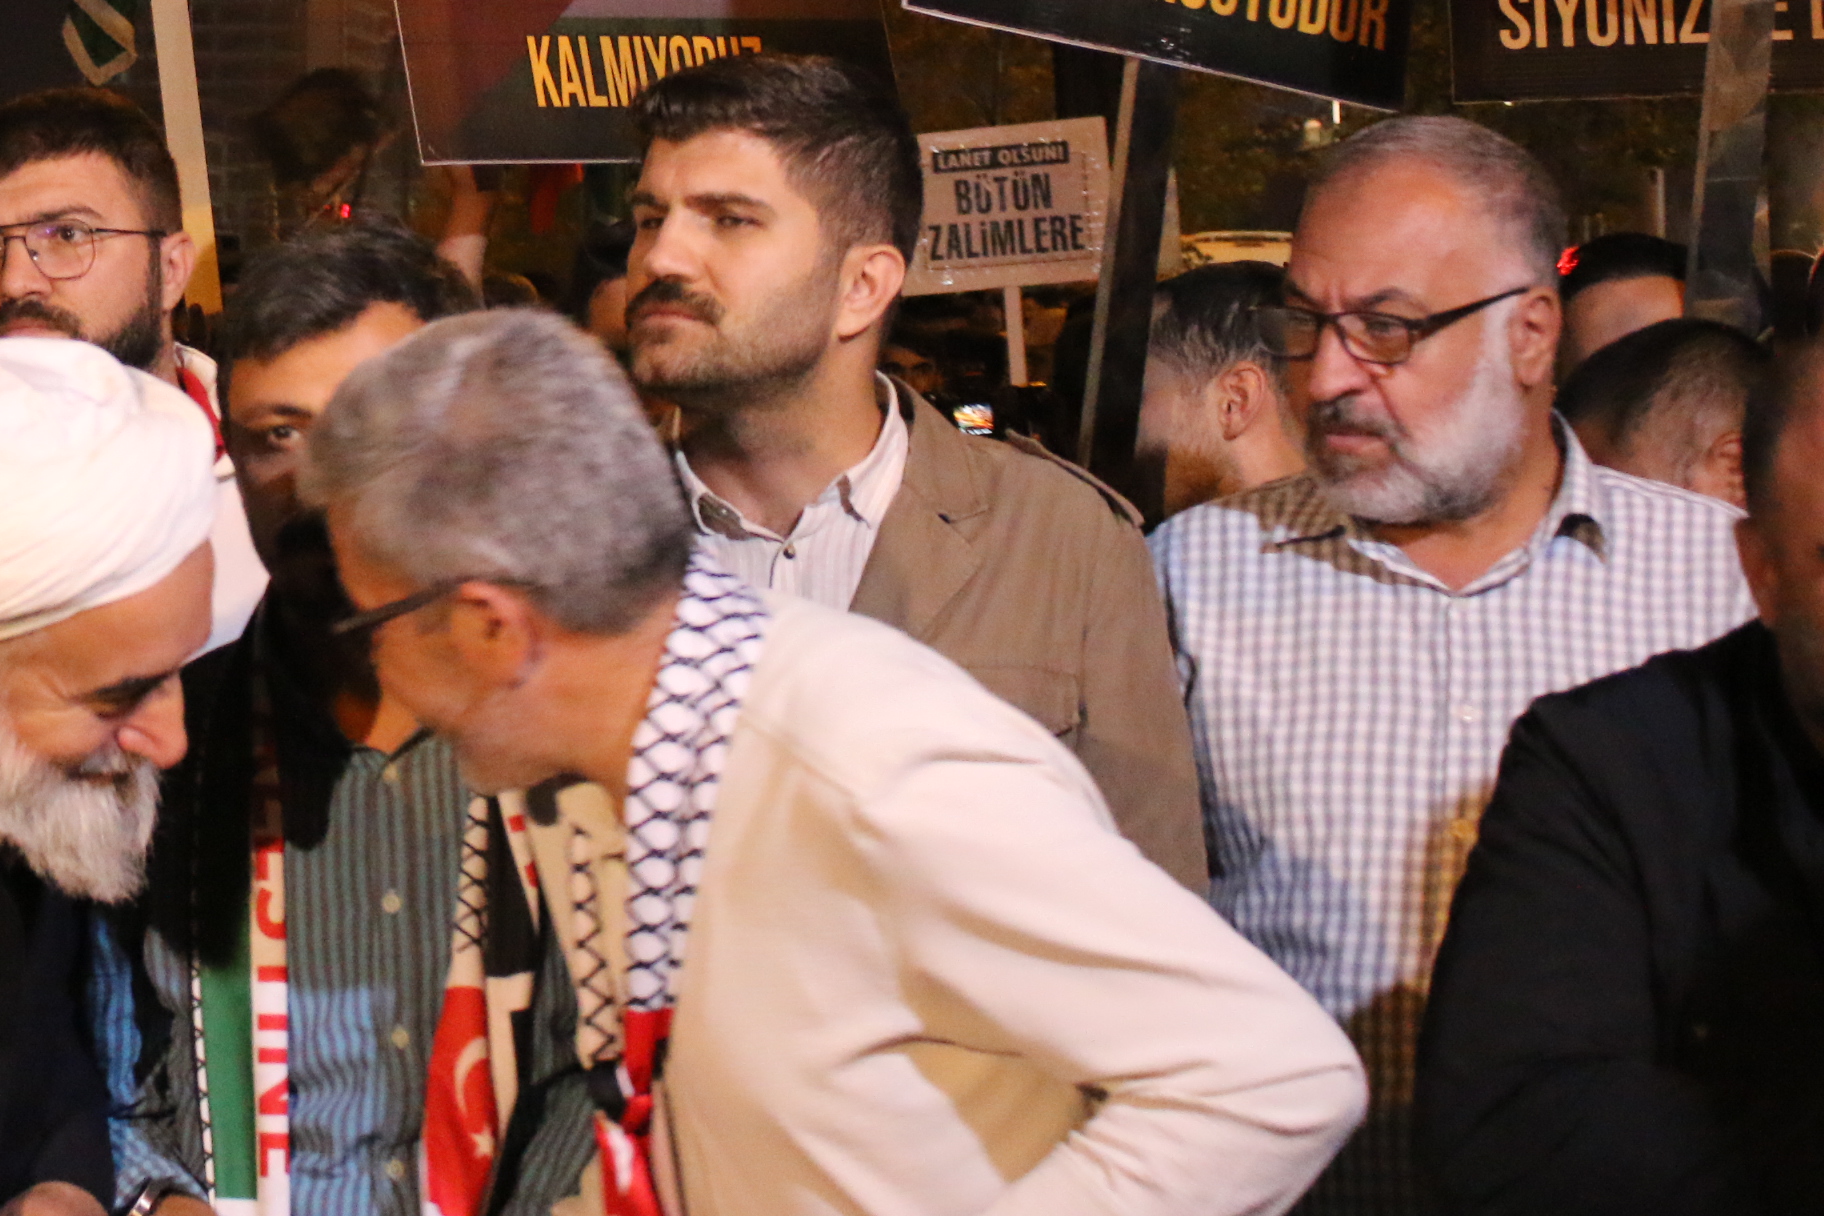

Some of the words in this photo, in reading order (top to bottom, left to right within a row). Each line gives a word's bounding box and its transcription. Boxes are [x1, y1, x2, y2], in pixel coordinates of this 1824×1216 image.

[937, 151, 992, 169] LANET
[997, 145, 1064, 166] OLSUN!
[954, 170, 1053, 215] BÜTÜN
[928, 214, 1086, 261] ZALİMLERE
